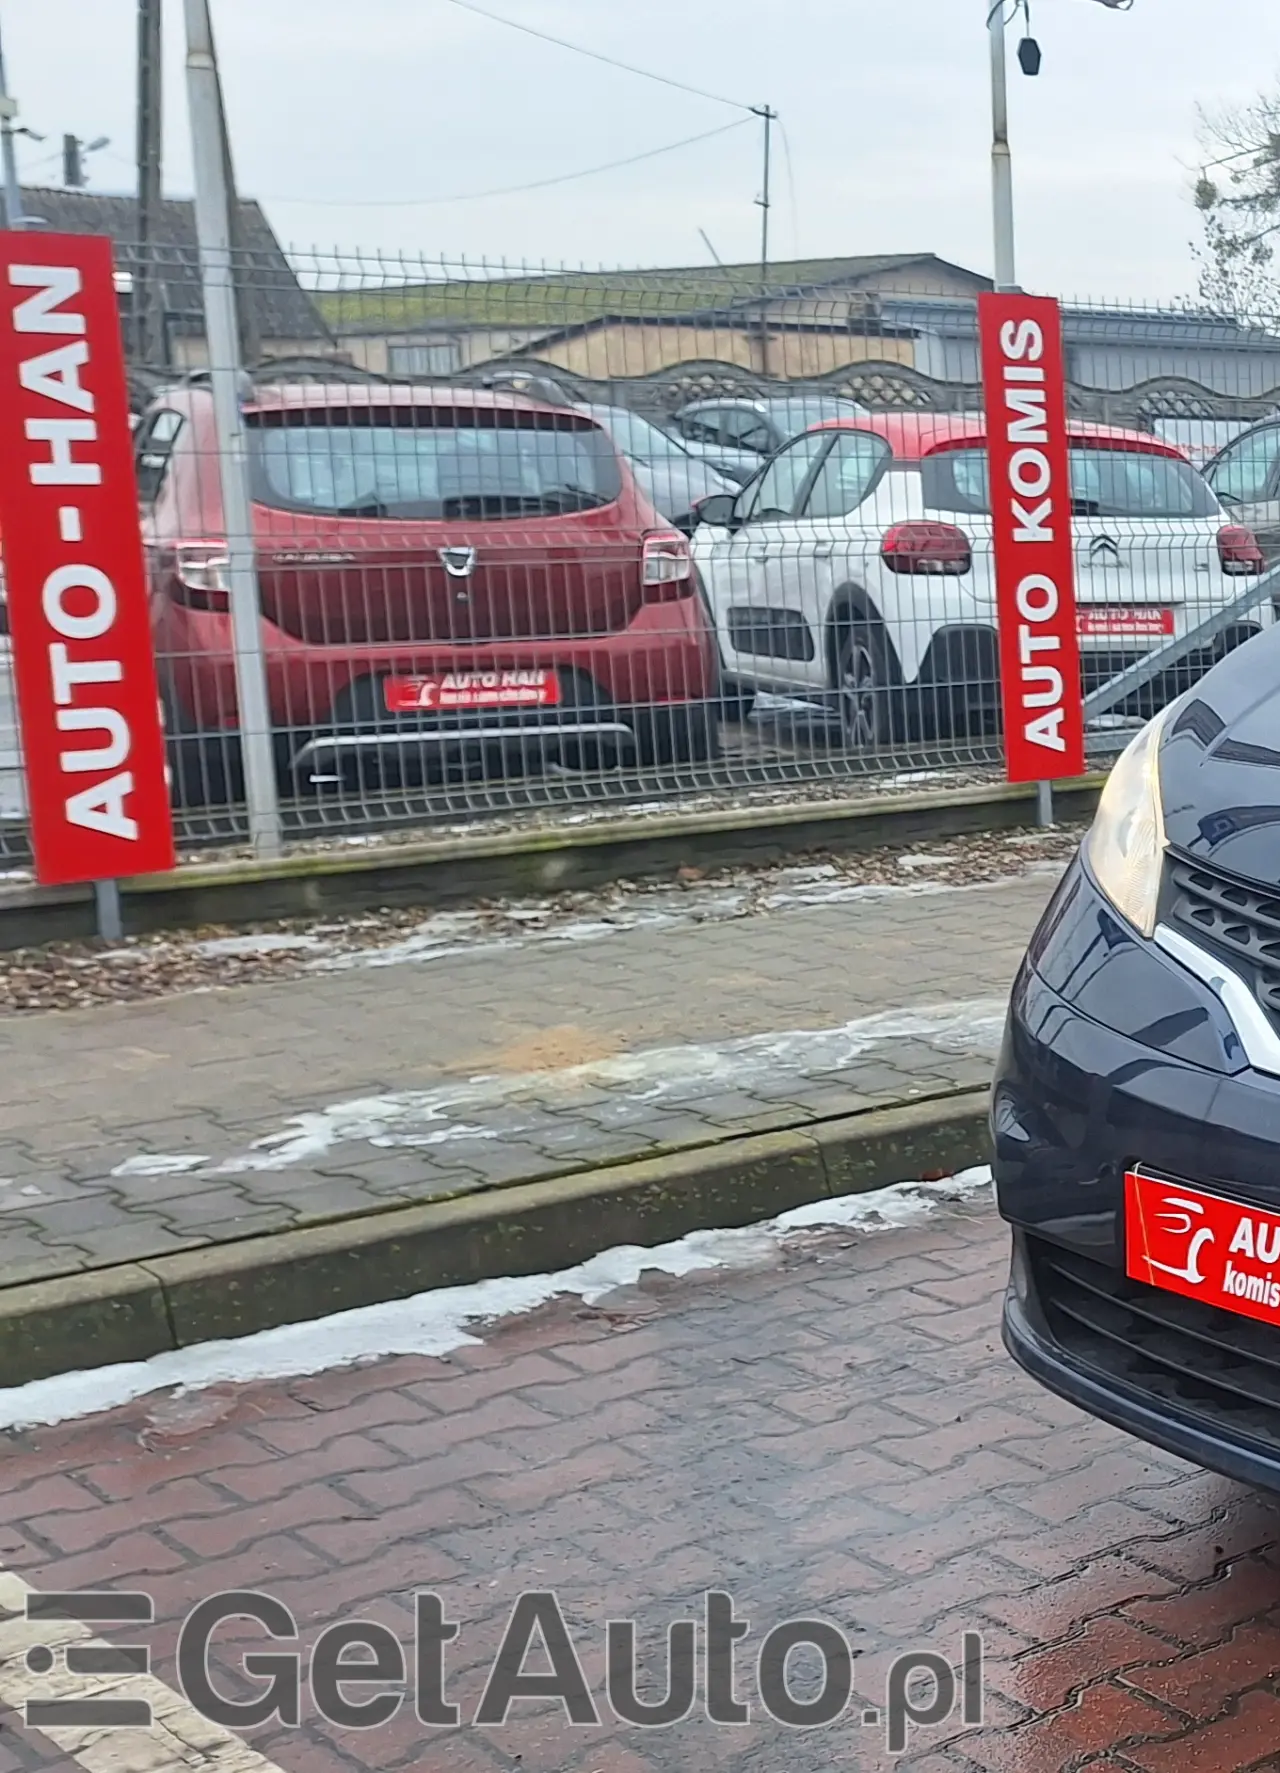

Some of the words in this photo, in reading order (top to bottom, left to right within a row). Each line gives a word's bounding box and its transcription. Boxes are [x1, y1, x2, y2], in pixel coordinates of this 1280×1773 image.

[8, 263, 102, 486] HAN
[1000, 318, 1054, 543] KOMIS
[42, 563, 138, 841] AUTO
[440, 673, 497, 689] AUTO
[501, 670, 546, 687] HAN
[1016, 573, 1066, 752] AUTO
